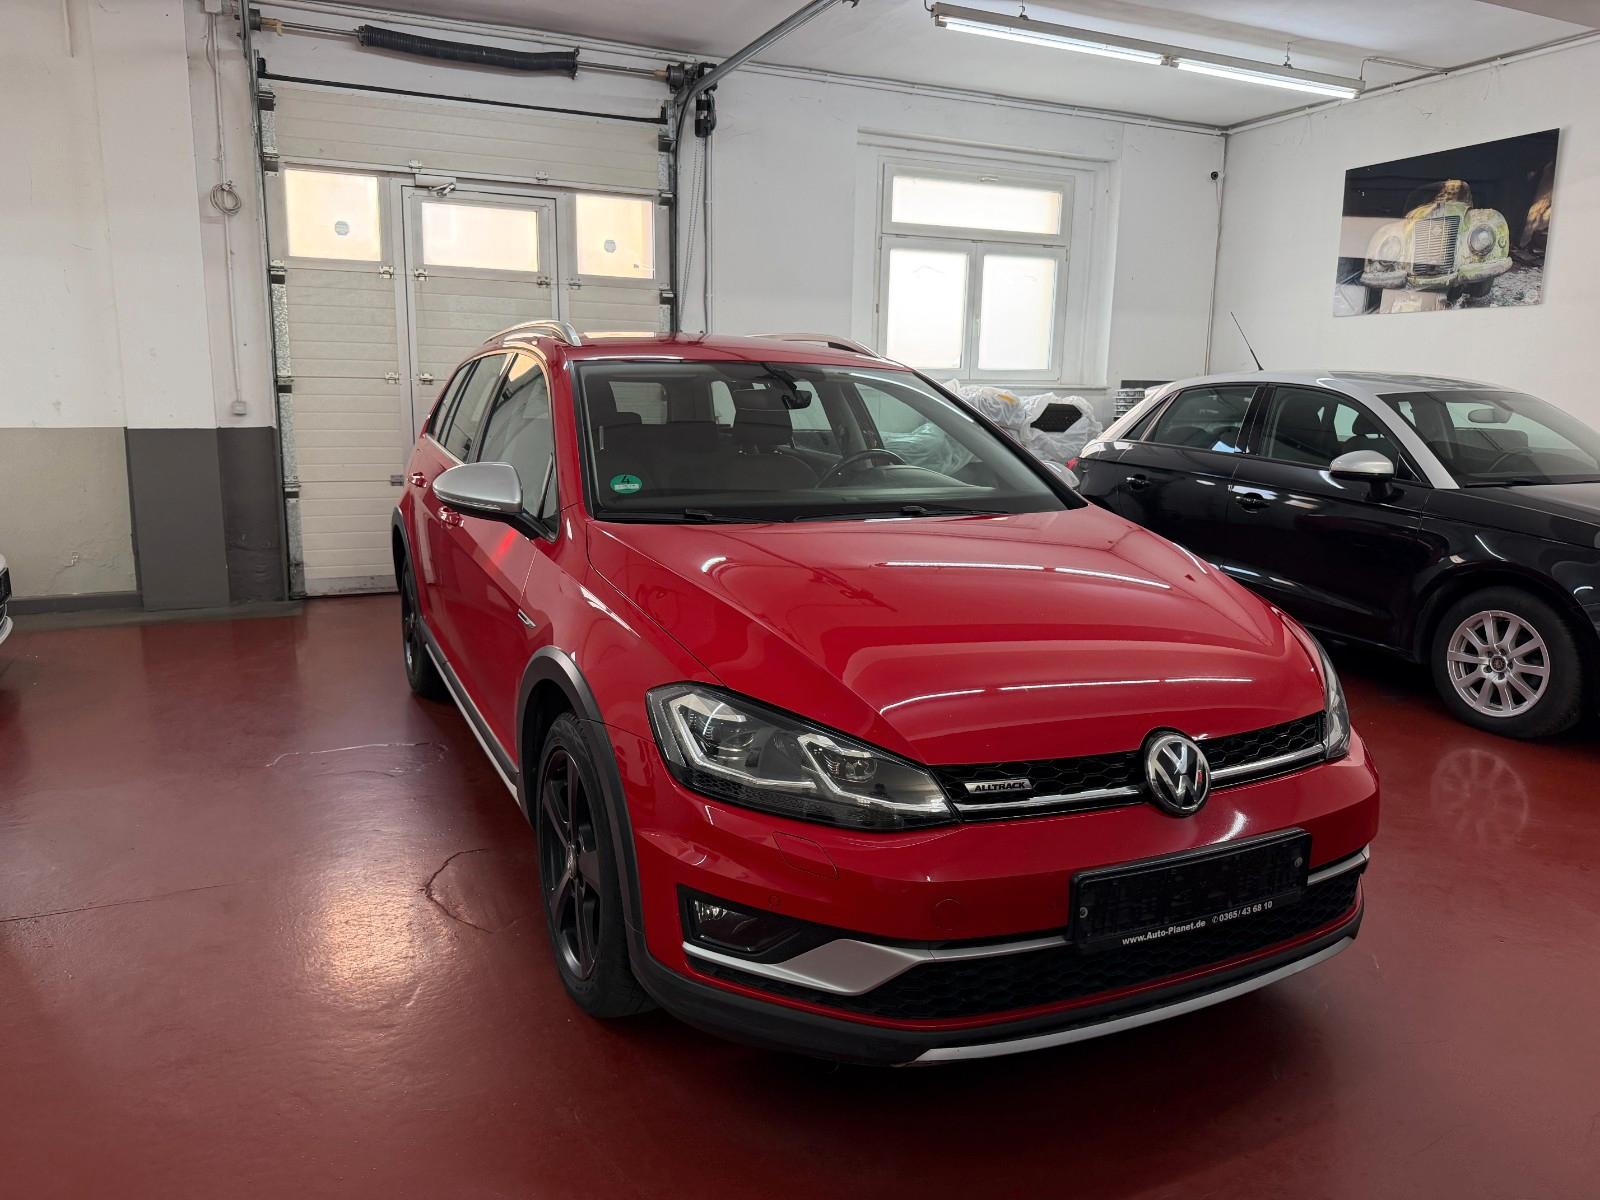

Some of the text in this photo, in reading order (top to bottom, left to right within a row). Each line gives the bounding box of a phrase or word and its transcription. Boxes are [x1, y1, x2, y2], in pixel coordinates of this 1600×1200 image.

[621, 475, 630, 484] 4
[974, 781, 1026, 792] ALLTRACK
[1149, 738, 1206, 808] VW
[1122, 920, 1206, 945] www.Auto-Planet.de
[1252, 903, 1262, 912] 68
[1264, 900, 1273, 910] 10
